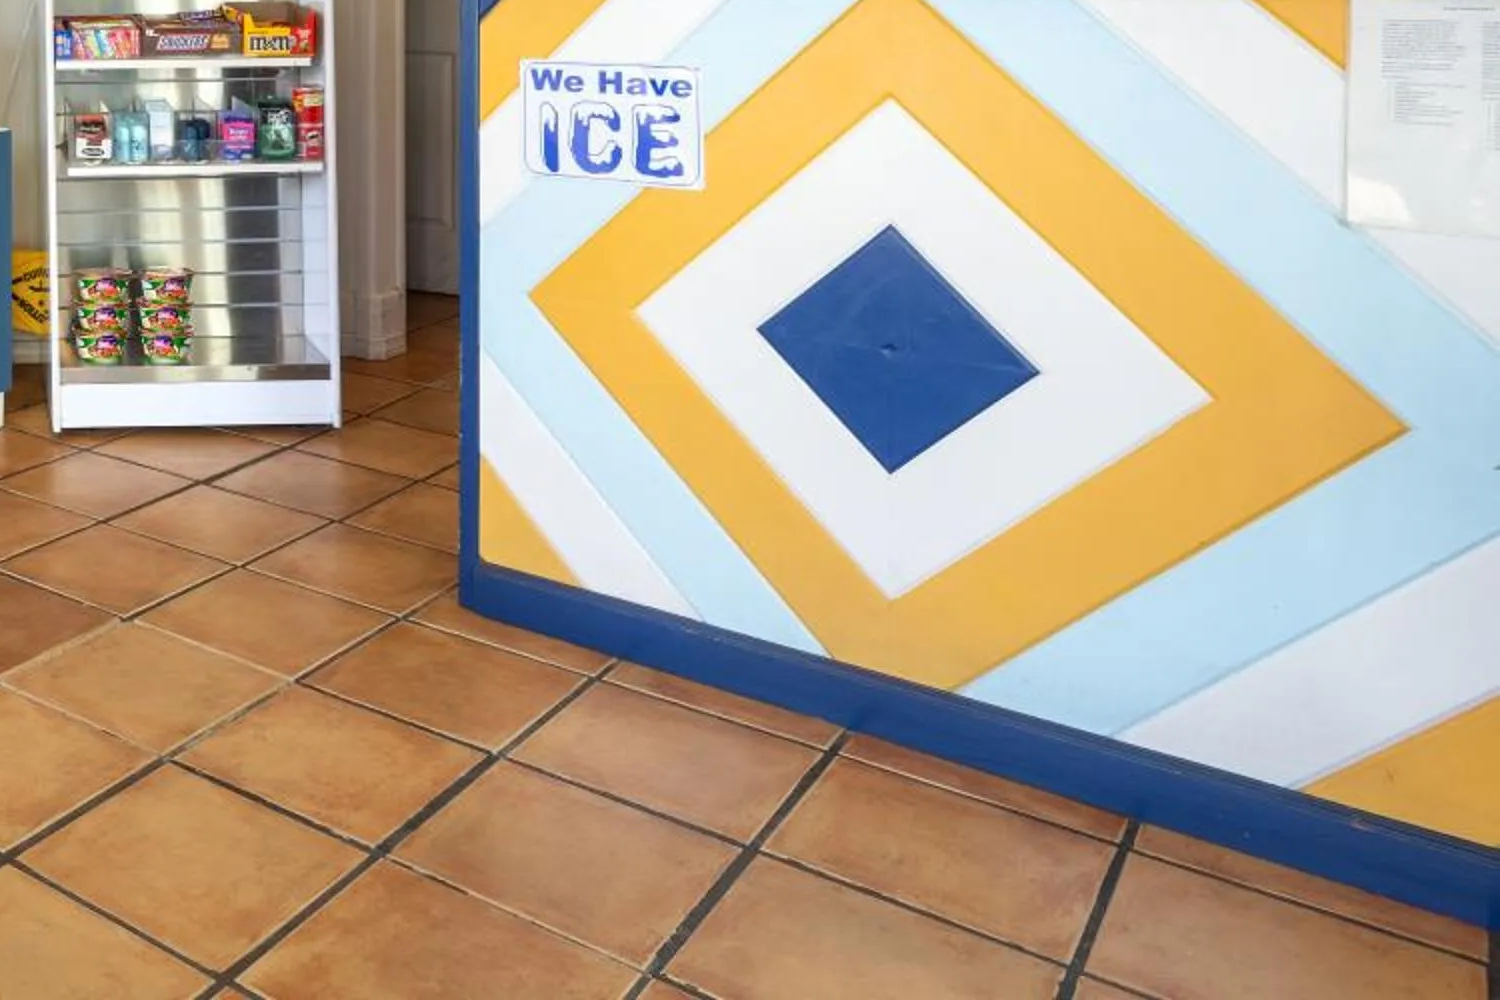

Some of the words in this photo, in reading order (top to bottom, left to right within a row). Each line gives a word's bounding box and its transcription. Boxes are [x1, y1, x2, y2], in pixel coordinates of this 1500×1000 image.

[530, 67, 584, 93] We
[598, 71, 693, 98] Have
[540, 99, 684, 178] ICE
